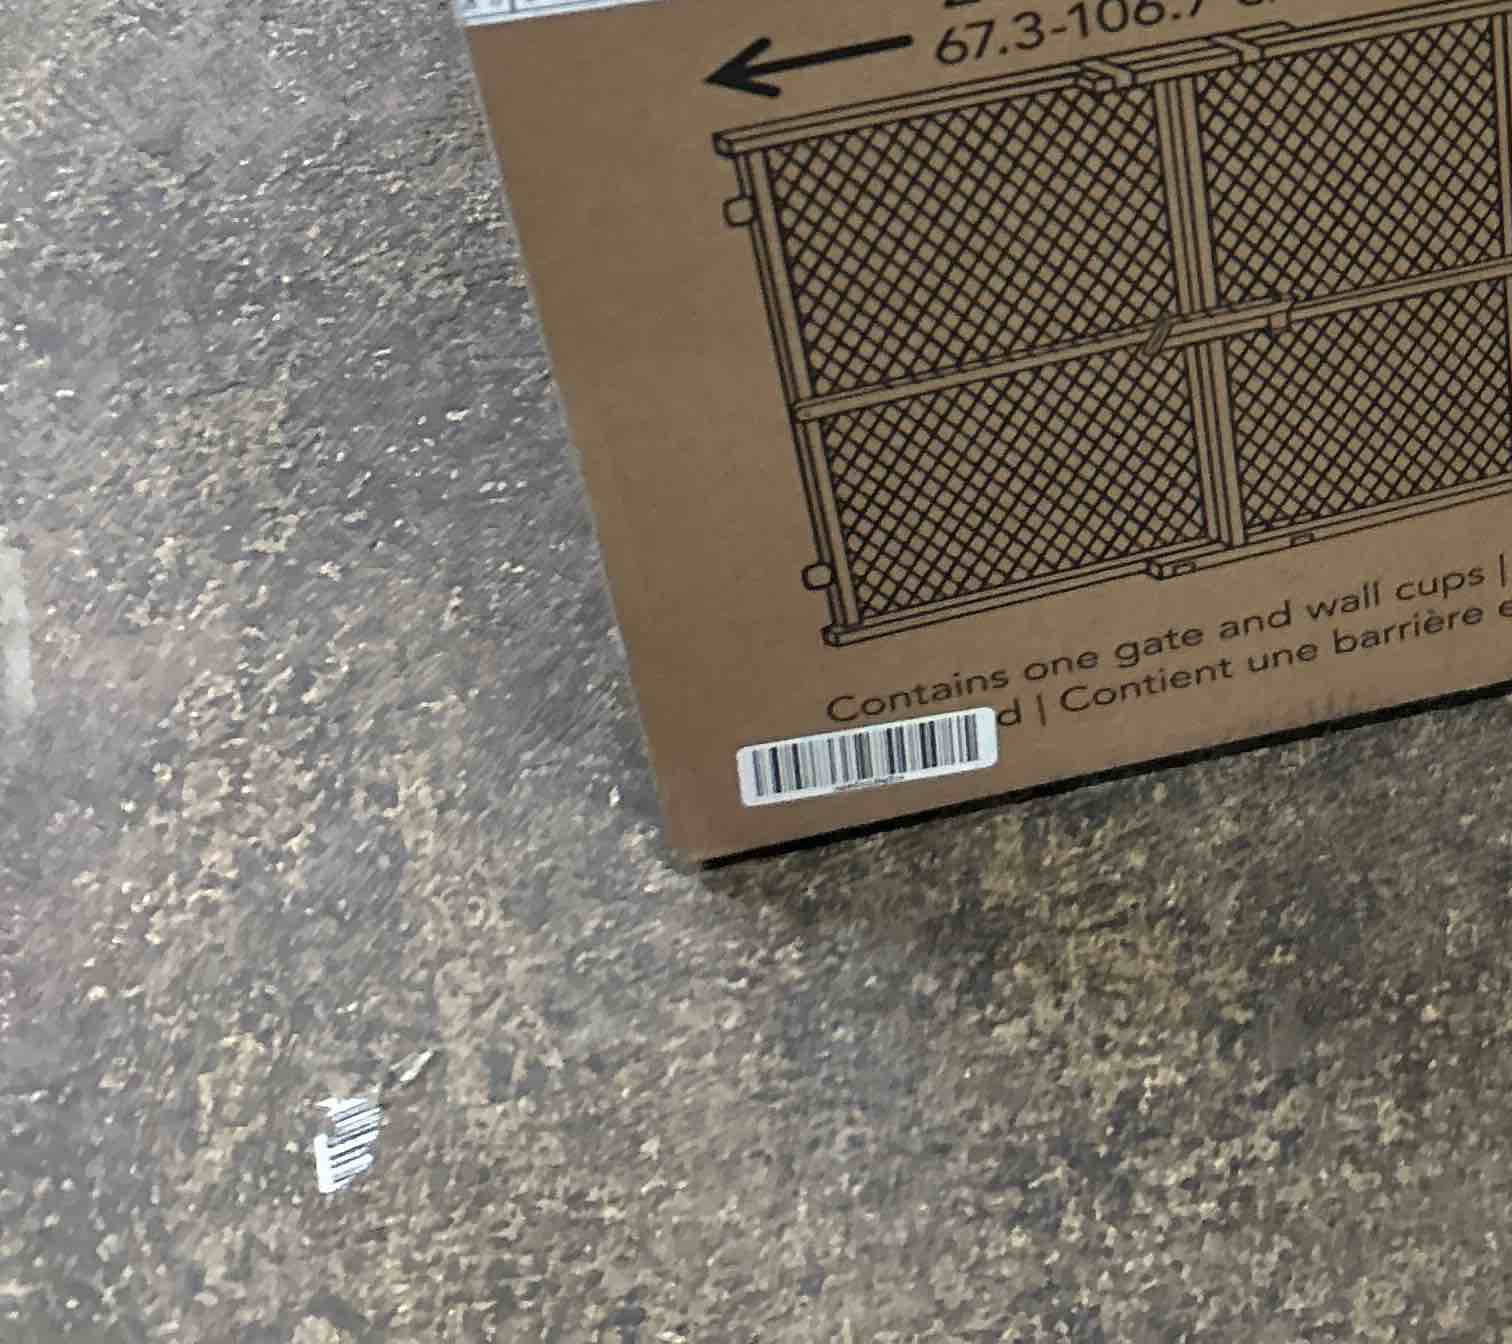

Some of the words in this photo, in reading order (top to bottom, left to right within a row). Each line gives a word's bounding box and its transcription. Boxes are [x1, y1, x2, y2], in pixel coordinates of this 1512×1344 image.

[825, 669, 1010, 722] Contains
[1024, 648, 1099, 682] one
[1113, 625, 1204, 670] gate
[1218, 606, 1293, 639] and
[1305, 580, 1382, 620] wall
[1395, 562, 1486, 607] cups
[1060, 656, 1234, 714] Contient
[1247, 638, 1320, 673] une
[1331, 602, 1485, 656] barrière
